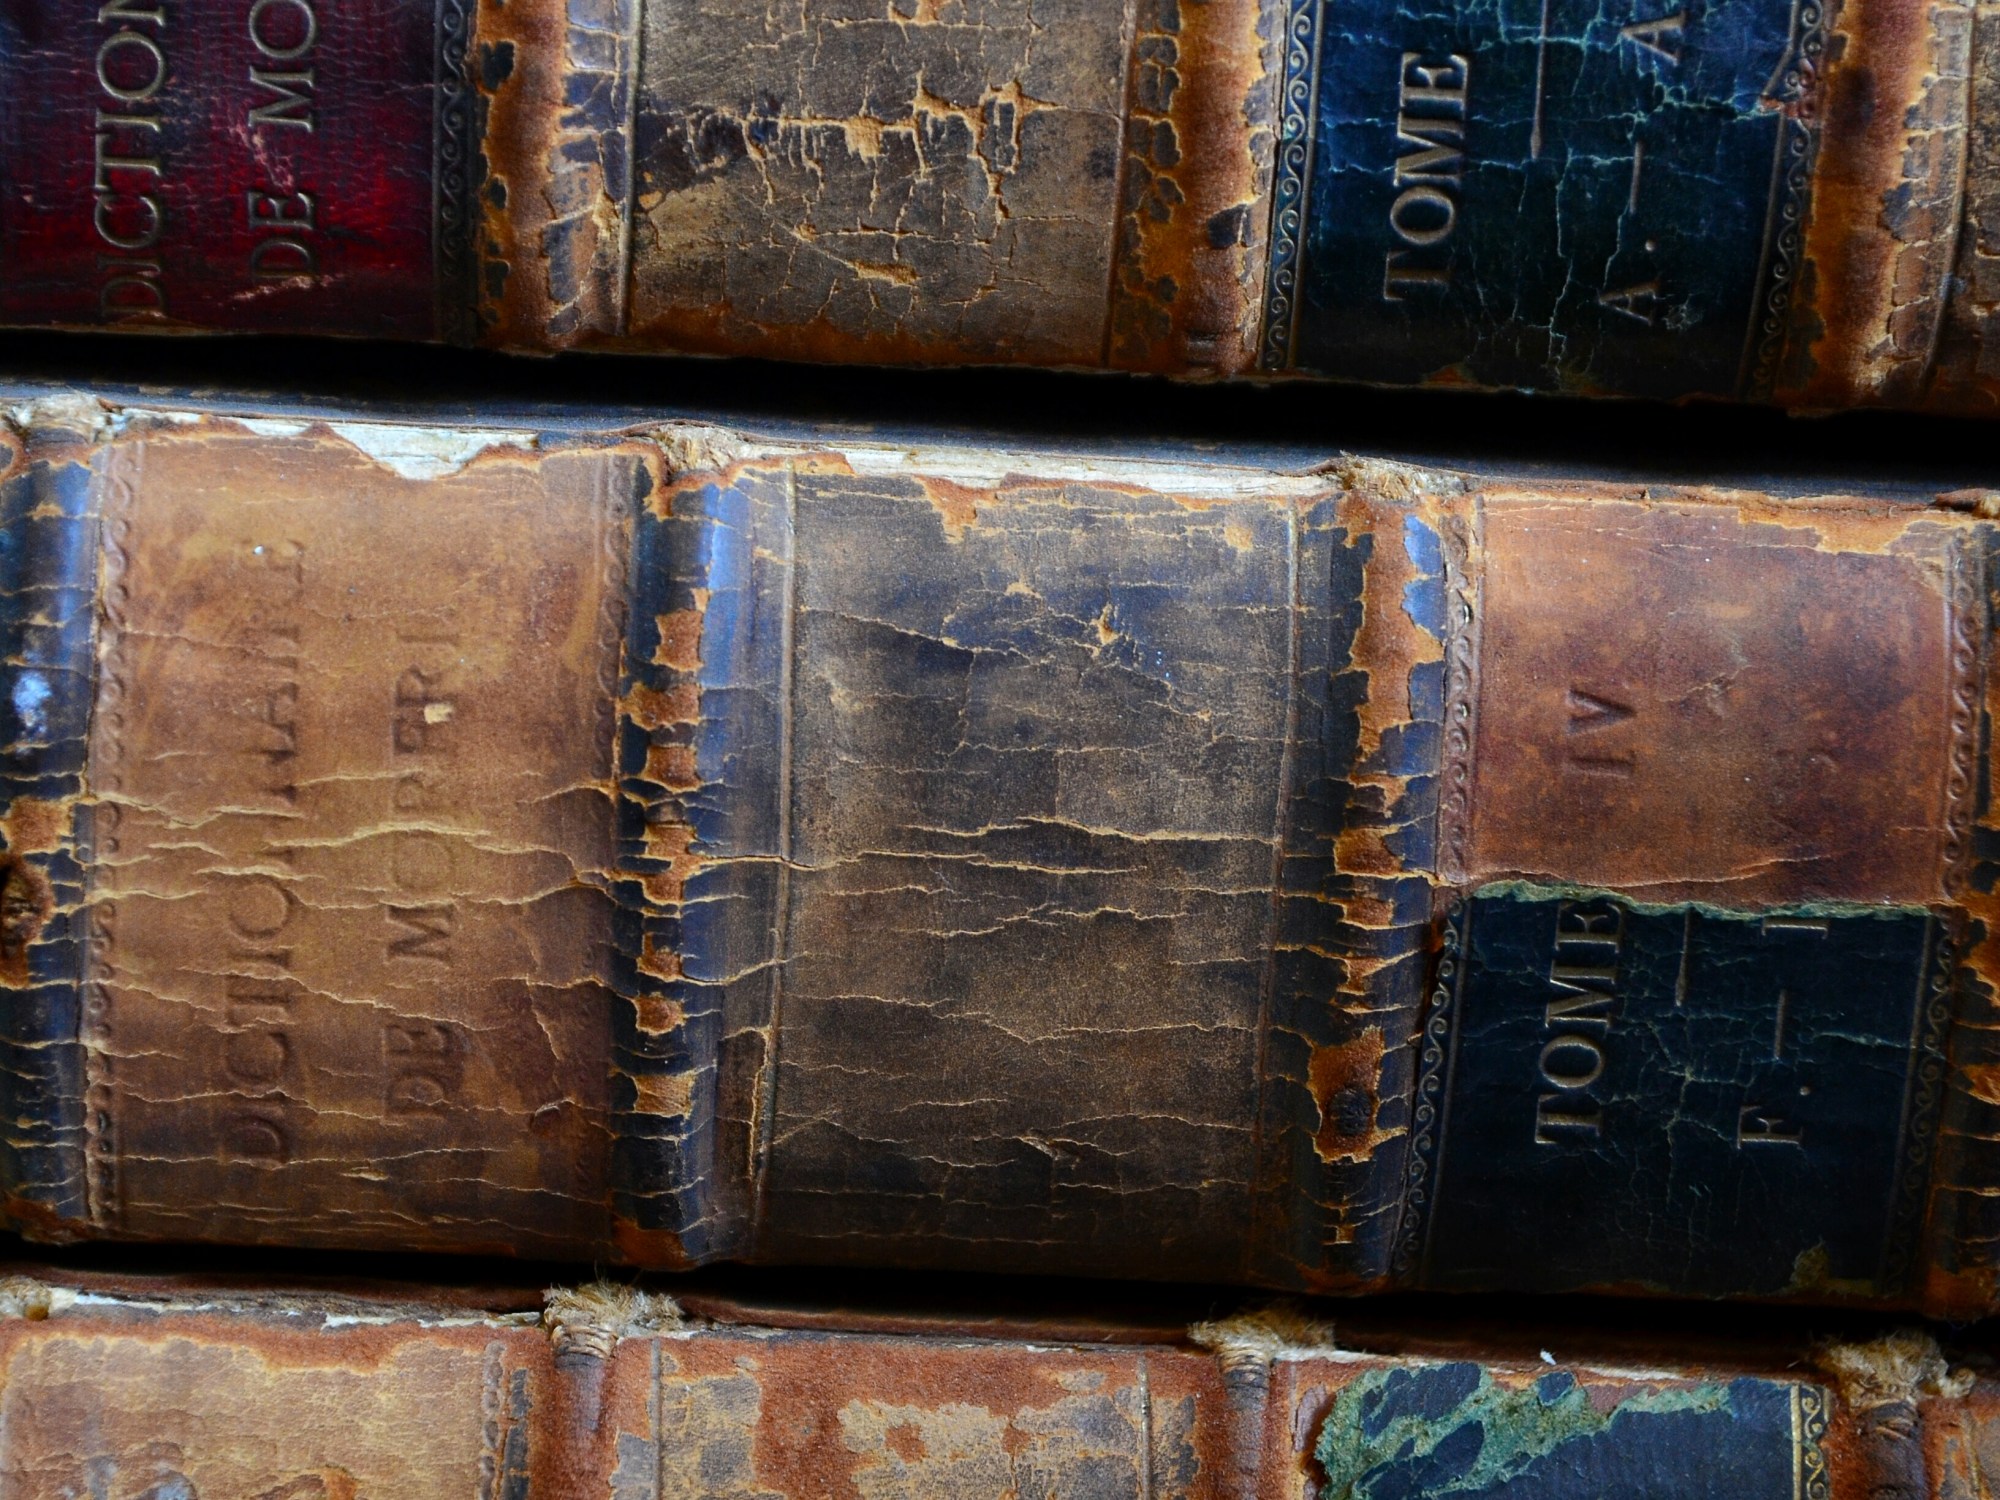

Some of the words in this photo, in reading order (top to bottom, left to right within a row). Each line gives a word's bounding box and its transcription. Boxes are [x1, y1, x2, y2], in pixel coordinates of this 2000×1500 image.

[1383, 52, 1469, 300] TOME
[249, 192, 316, 281] DE
[1567, 685, 1635, 778] IV
[383, 1020, 459, 1121] DE
[1535, 902, 1624, 1144] TOME
